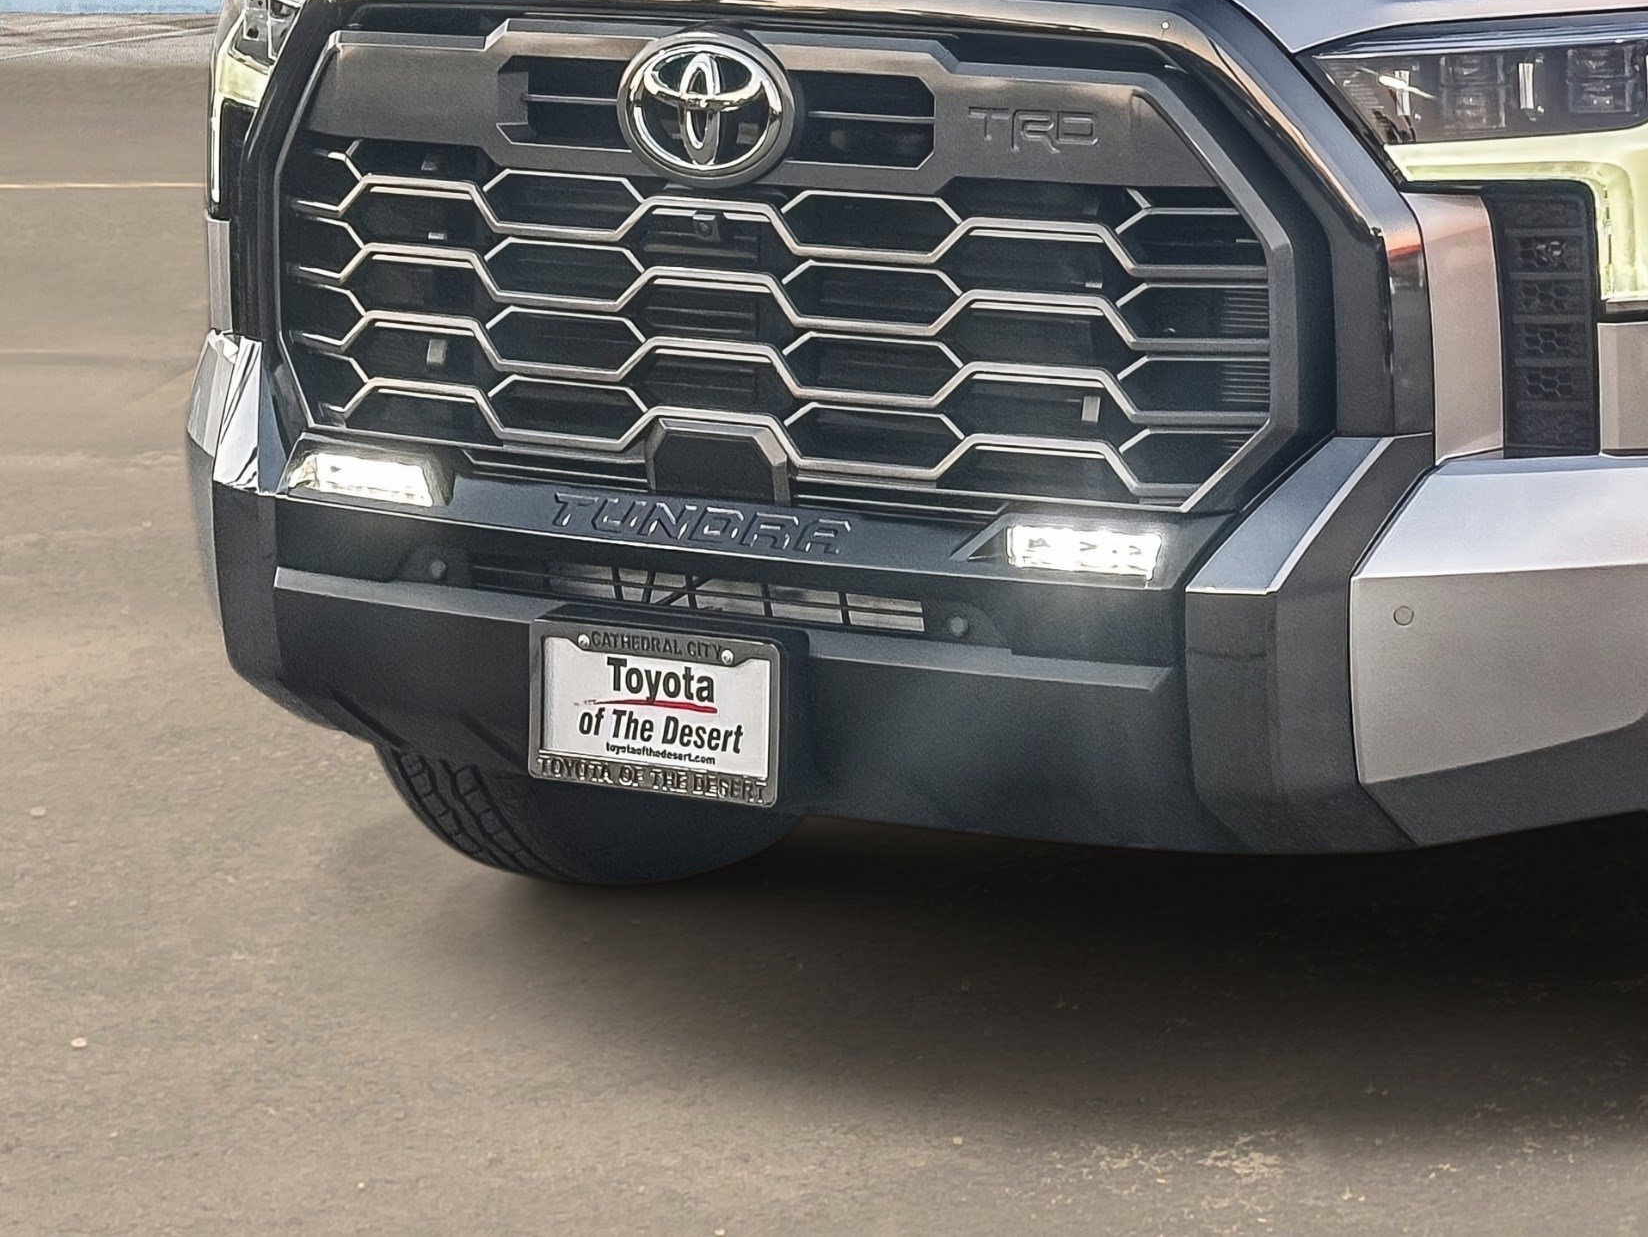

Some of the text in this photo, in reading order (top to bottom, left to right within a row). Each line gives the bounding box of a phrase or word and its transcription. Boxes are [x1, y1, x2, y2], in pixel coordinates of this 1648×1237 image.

[968, 106, 1099, 154] TRD
[554, 492, 851, 555] TUNDRA
[591, 630, 723, 660] CATHEDRAL CITY
[606, 656, 716, 705] Toyota
[578, 707, 744, 755] of The Desert
[605, 742, 716, 766] toyotaofthedesert.com
[537, 757, 768, 803] TOYOTA OF THE DESERT
